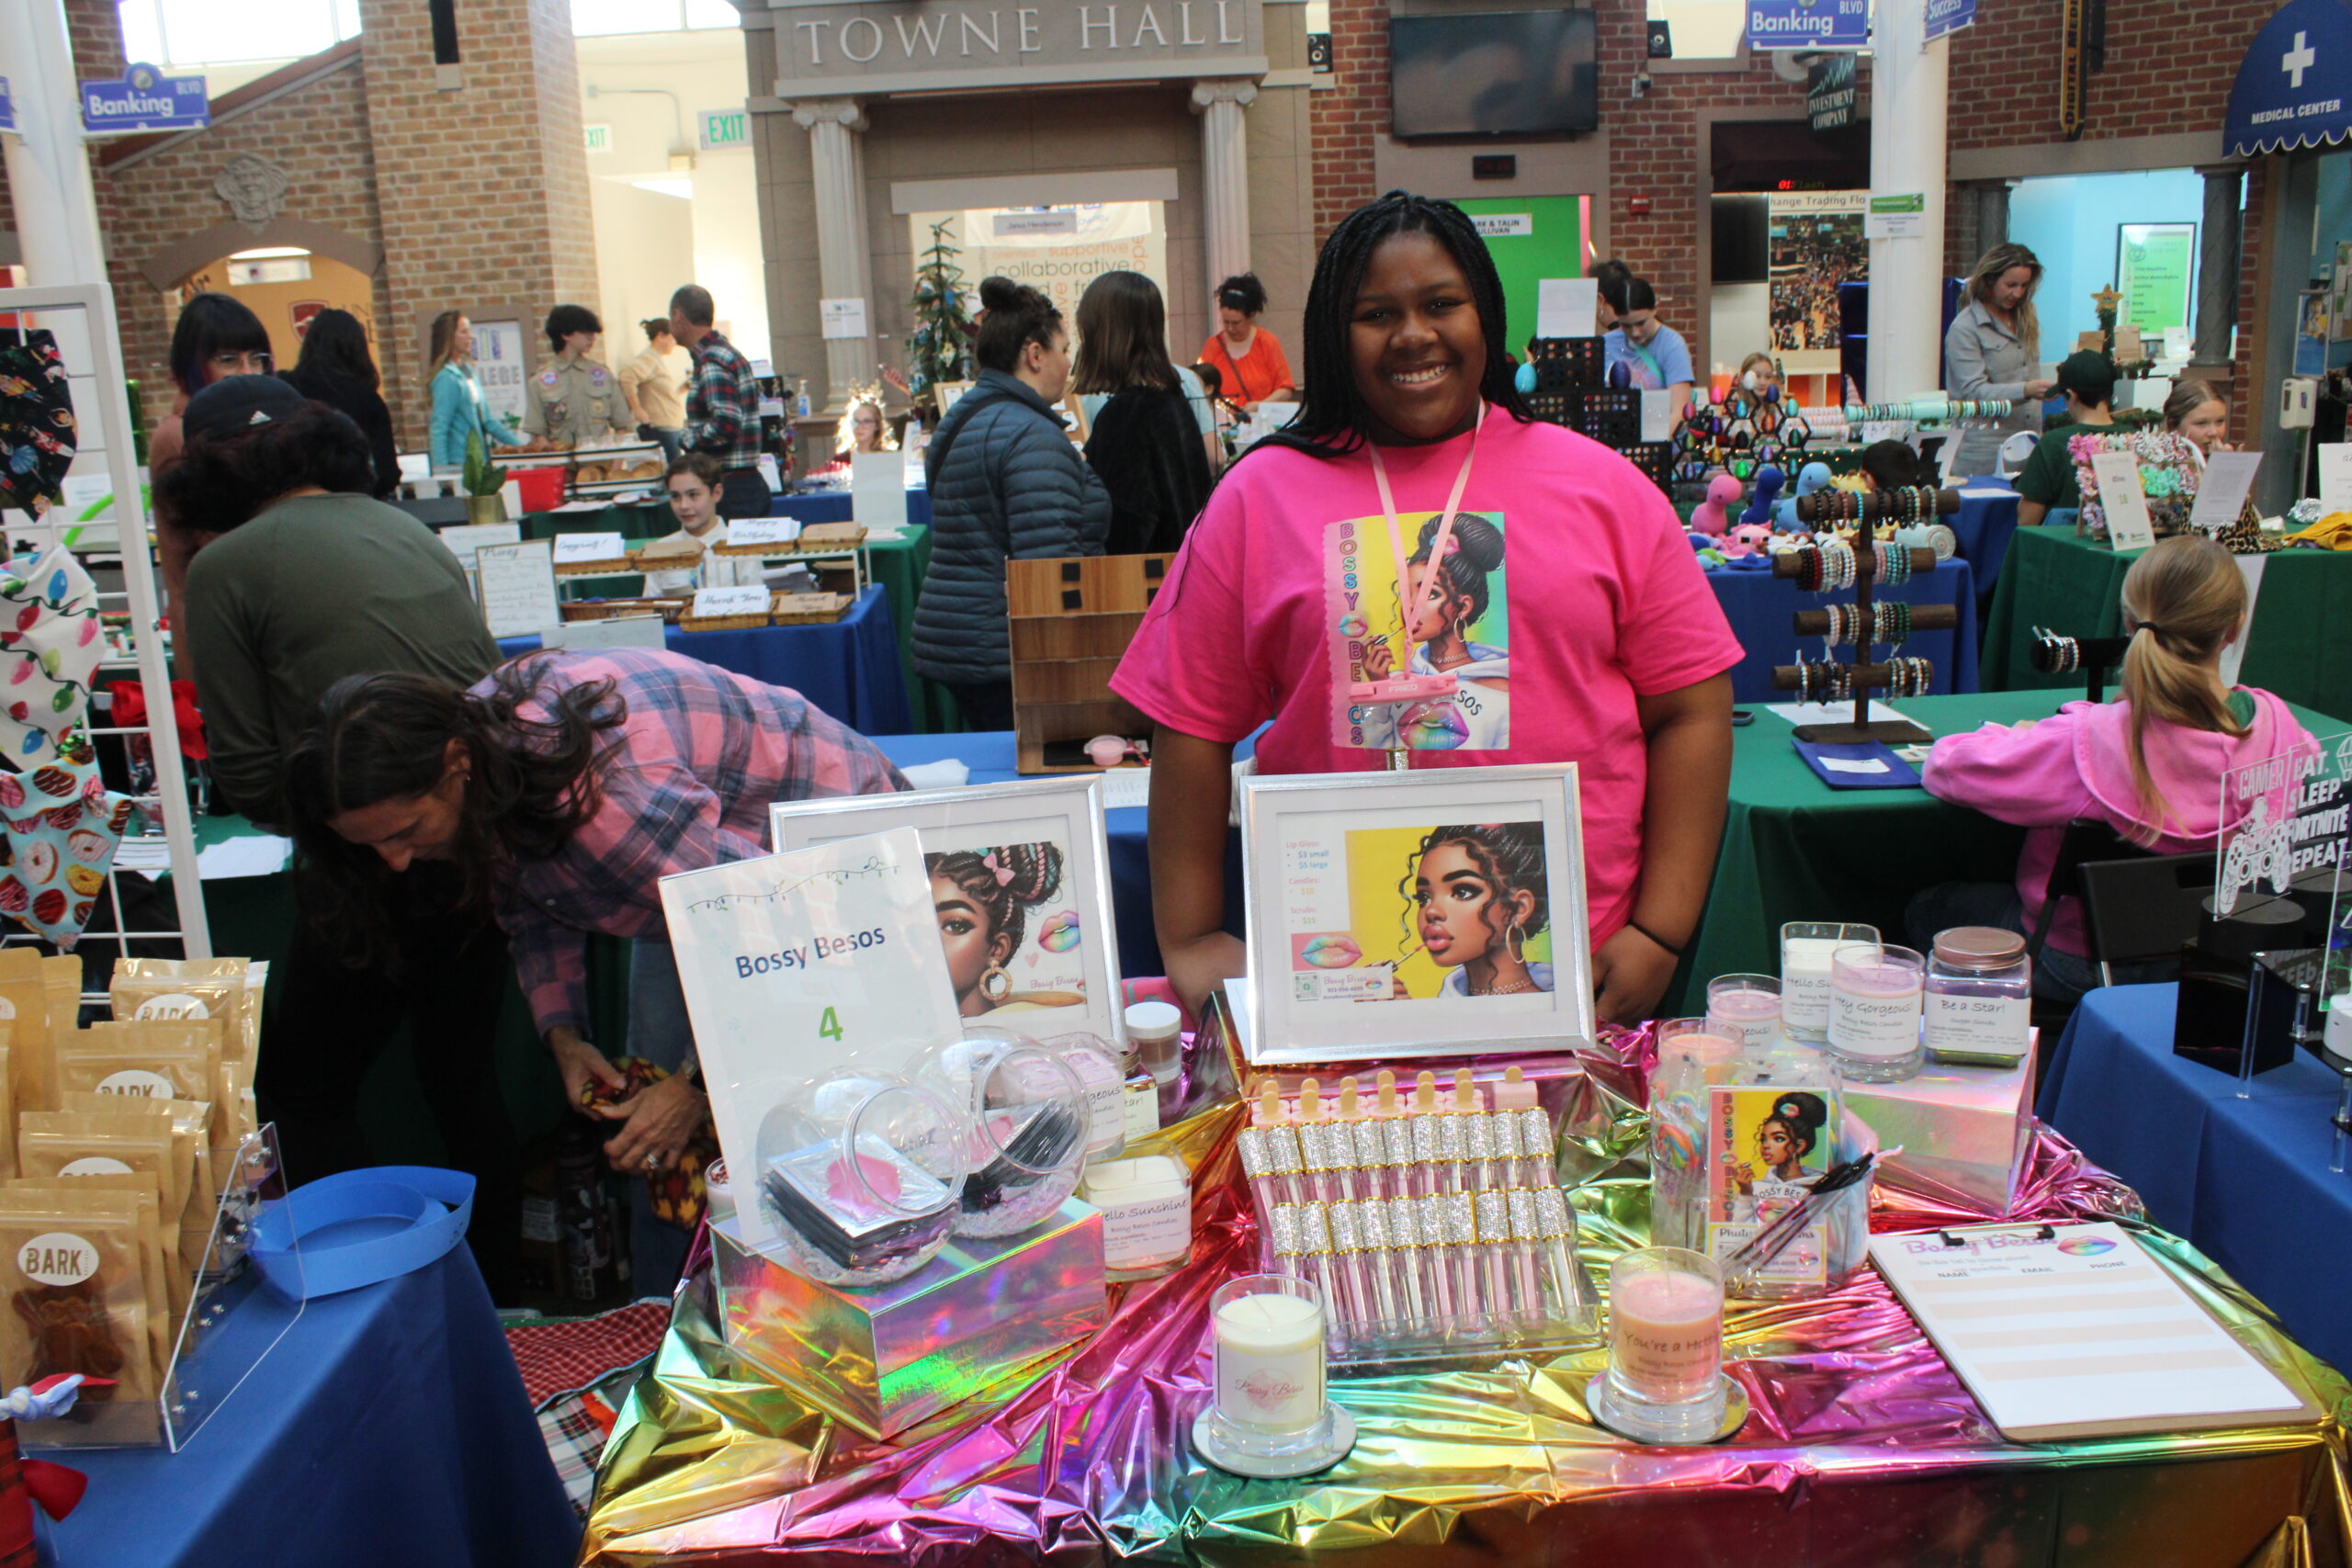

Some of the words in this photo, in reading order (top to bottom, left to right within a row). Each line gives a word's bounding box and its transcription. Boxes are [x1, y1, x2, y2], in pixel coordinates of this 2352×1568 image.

[1839, 0, 1863, 15] BLVD
[797, 8, 1041, 65] TOWNE
[1080, 1, 1243, 50] HALL
[1752, 9, 1834, 36] Banking
[176, 80, 202, 95] BLVD
[88, 91, 175, 118] Banking
[1808, 90, 1854, 114] INVESTMENT
[2251, 107, 2295, 125] MEDICAL
[2297, 98, 2341, 118] CENTER
[707, 114, 745, 143] EXIT
[1813, 108, 1848, 130] COMPANY
[1806, 195, 1847, 206] Trading
[1498, 220, 1520, 228] TALIN
[1048, 242, 1129, 258] supportive
[994, 258, 1130, 277] collaborative
[1340, 523, 1360, 611] BOSSY
[1348, 640, 1365, 746] BEOS
[2293, 750, 2330, 783] EAT.
[2239, 759, 2285, 800] GAMER
[2289, 777, 2344, 813] SLEEP.
[1309, 850, 1329, 858] small
[1309, 861, 1329, 870] large
[2290, 837, 2351, 874] EPEAT.
[736, 946, 807, 978] Bossy
[814, 928, 886, 959] Besos
[1029, 978, 1054, 990] Bossy
[1786, 976, 1814, 987] Hello
[1835, 996, 1853, 1014] Hey
[1940, 999, 1956, 1010] Be
[1971, 1002, 2006, 1014] Star!
[819, 1007, 844, 1043] 4
[26, 1247, 82, 1277] BARK
[2089, 1260, 2128, 1270] PHONE
[1623, 1330, 1668, 1352] You're
[1672, 1342, 1680, 1352] a
